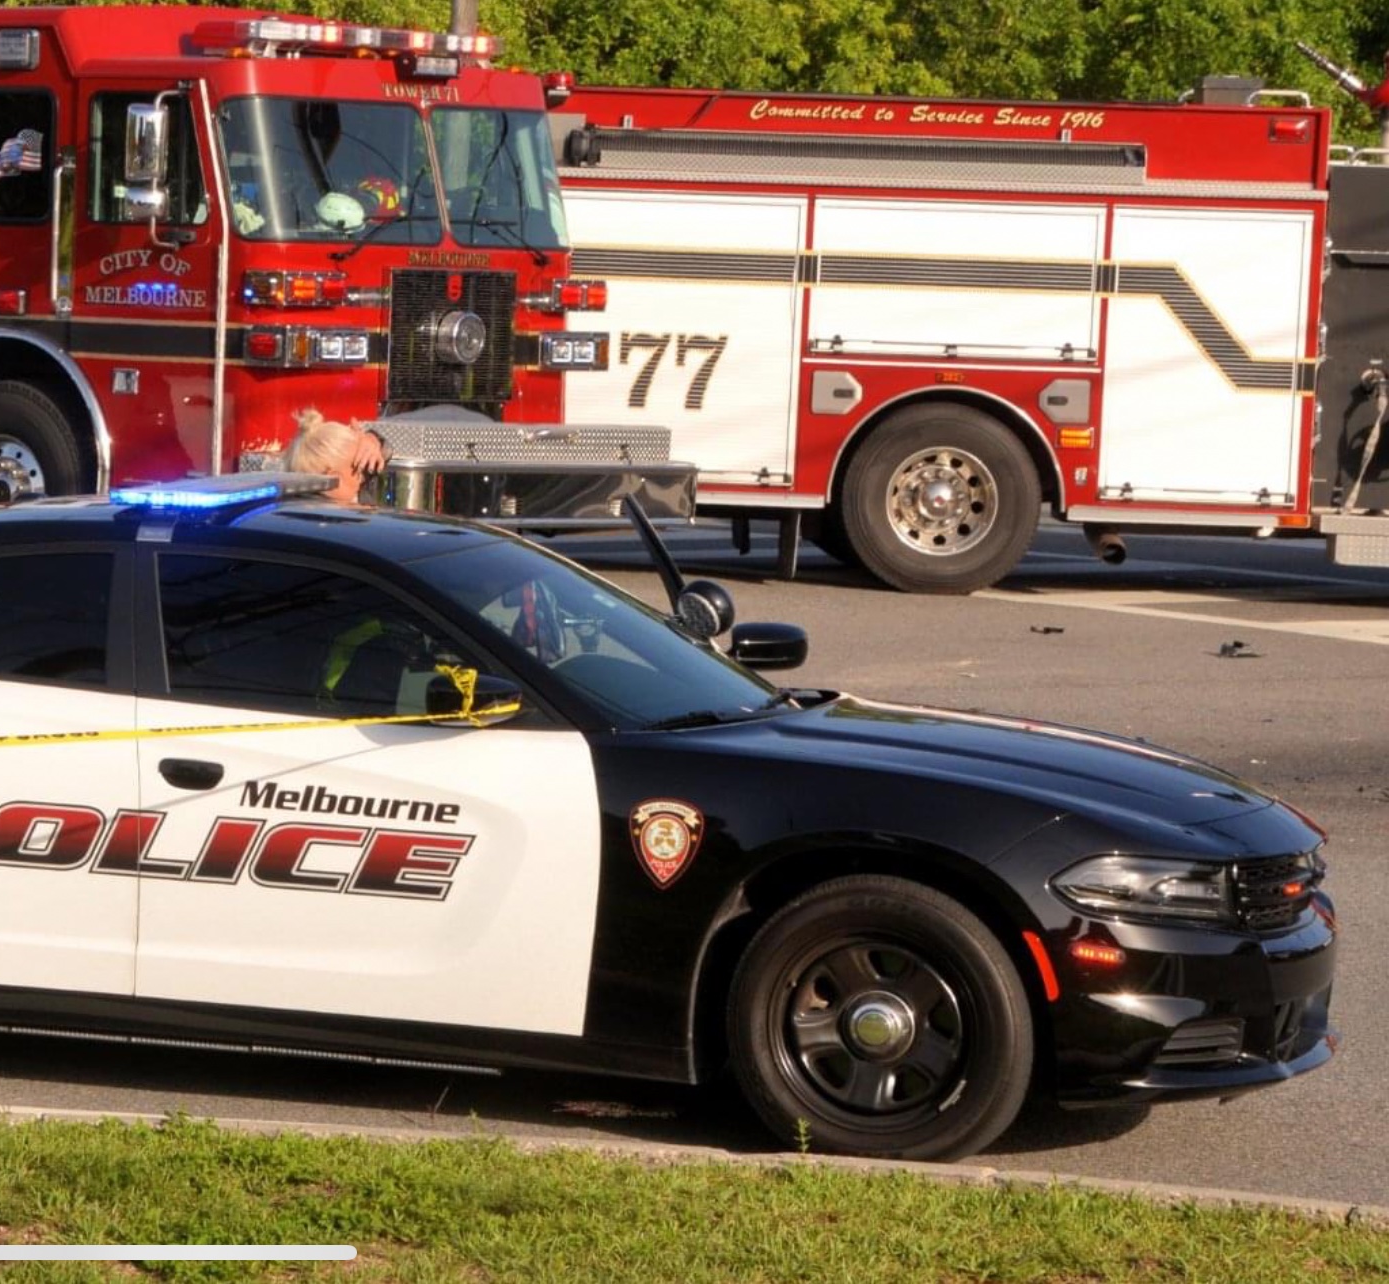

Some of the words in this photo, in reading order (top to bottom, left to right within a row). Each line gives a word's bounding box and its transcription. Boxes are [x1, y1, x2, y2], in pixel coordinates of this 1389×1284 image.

[749, 99, 866, 121] Committed
[874, 108, 895, 121] to
[909, 104, 984, 125] Service
[993, 107, 1052, 127] Since
[1060, 111, 1105, 128] 1916
[99, 250, 153, 275] CITY
[160, 253, 191, 277] OF
[85, 285, 207, 307] MELBOURNE
[619, 332, 728, 409] 77
[240, 780, 461, 825] Melbourne
